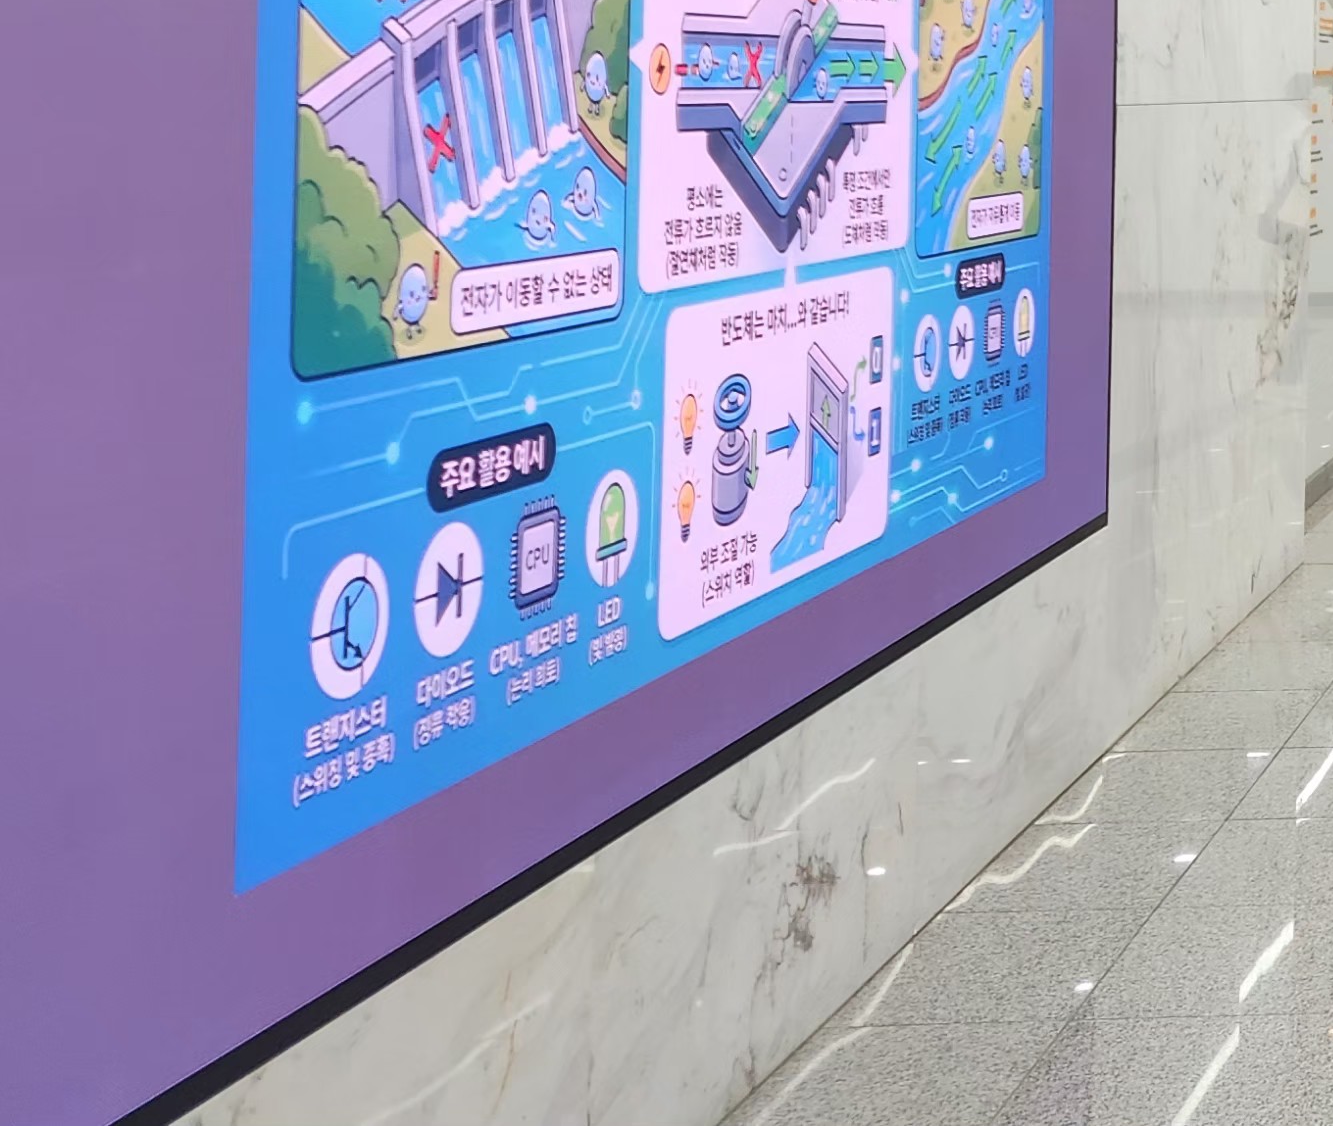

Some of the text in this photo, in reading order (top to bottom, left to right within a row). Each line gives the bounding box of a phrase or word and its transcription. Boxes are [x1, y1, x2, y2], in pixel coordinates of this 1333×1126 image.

[460, 262, 613, 318] 전자가 이동할 수 없는 상태
[721, 309, 764, 346] 반도체는
[439, 434, 547, 498] 주요 활용 예시
[525, 543, 550, 571] CPU
[700, 530, 758, 573] 외부 조절 가능
[597, 597, 621, 628] LED
[525, 619, 563, 657] 메모리
[416, 659, 475, 708] 다이오드
[304, 695, 388, 759] 트랜지스터
[344, 747, 361, 780] 및
